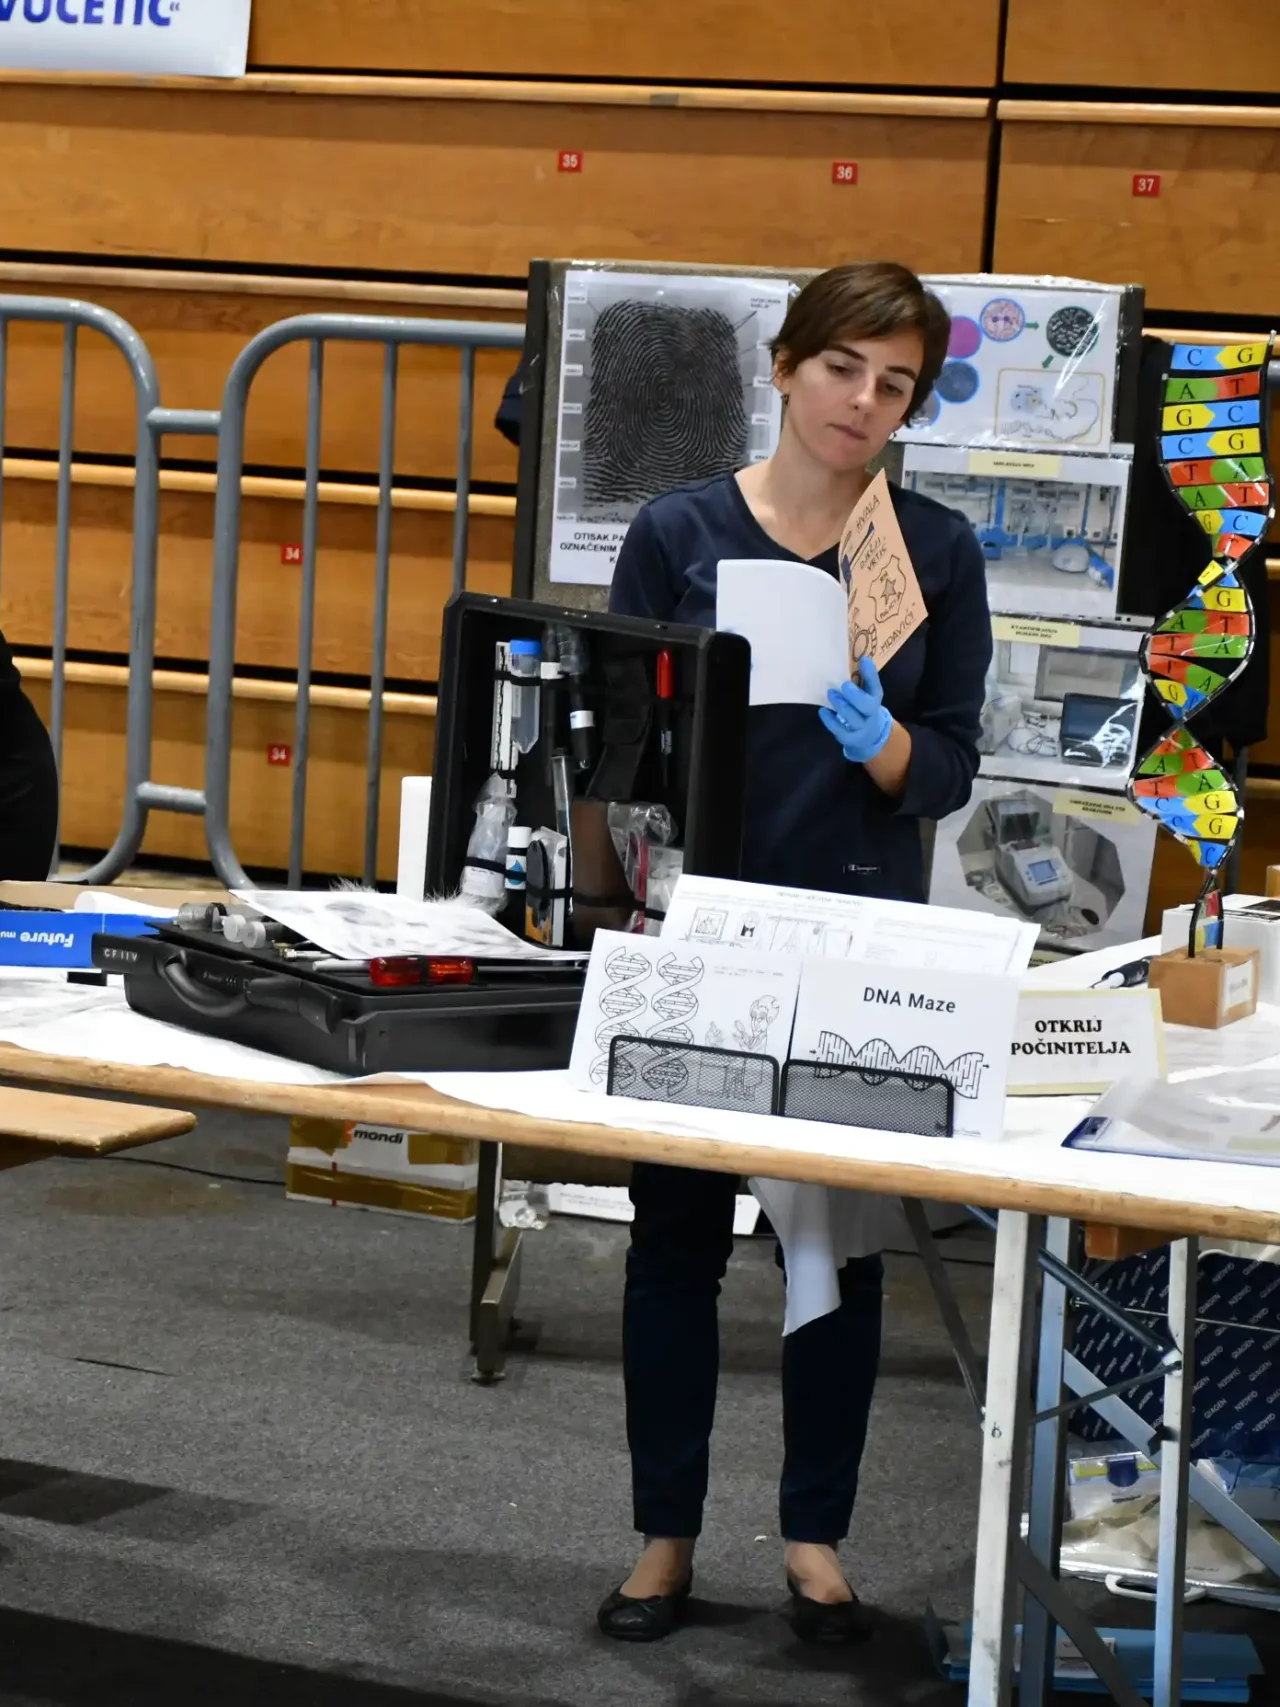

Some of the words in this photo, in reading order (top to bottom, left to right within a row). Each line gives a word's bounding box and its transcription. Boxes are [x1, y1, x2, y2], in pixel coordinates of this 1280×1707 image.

[563, 154, 578, 168] 35
[837, 166, 853, 180] 36
[1138, 178, 1154, 192] 37
[1187, 349, 1202, 366] C
[1238, 347, 1253, 364] G
[1179, 382, 1196, 400] A
[1230, 378, 1244, 395] T
[1176, 409, 1192, 426] G
[1228, 406, 1243, 422] C
[1178, 438, 1193, 454] C
[1228, 433, 1244, 450] G
[1184, 464, 1198, 481] T
[1234, 462, 1250, 478] A
[1194, 490, 1208, 508] A
[1238, 486, 1253, 504] T
[1204, 514, 1212, 532] G
[1233, 514, 1248, 530] C
[574, 532, 609, 541] OTISAK
[612, 534, 625, 542] PA
[286, 547, 300, 560] 34
[560, 542, 616, 552] OZNAČENIM
[1216, 591, 1231, 607] G
[1171, 614, 1185, 630] A
[1220, 617, 1234, 633] T
[1166, 636, 1178, 651] T
[1215, 638, 1230, 654] A
[1164, 660, 1176, 674] T
[1199, 675, 1212, 692] A
[1168, 684, 1178, 702] G
[1154, 757, 1166, 773] A
[1189, 752, 1202, 768] T
[1150, 780, 1164, 796] T
[1198, 775, 1212, 791] A
[1155, 797, 1170, 812] C
[1204, 794, 1220, 811] G
[1209, 818, 1224, 834] G
[20, 931, 74, 948] Future
[863, 986, 902, 1006] DNA
[908, 992, 956, 1014] Maze
[1034, 1019, 1102, 1033] OTKRIJ
[1010, 1038, 1132, 1056] POČINITELJA
[354, 1130, 404, 1144] mondi
[1200, 1345, 1224, 1367] QIAGEN
[1232, 1338, 1255, 1359] QIAGEN
[1217, 1368, 1241, 1389] QIAGEN
[1248, 1360, 1272, 1382] QIAGEN
[1204, 1398, 1228, 1419] QIAGEN
[1234, 1390, 1258, 1412] QIAGEN
[1252, 1413, 1276, 1432] QIAGEN
